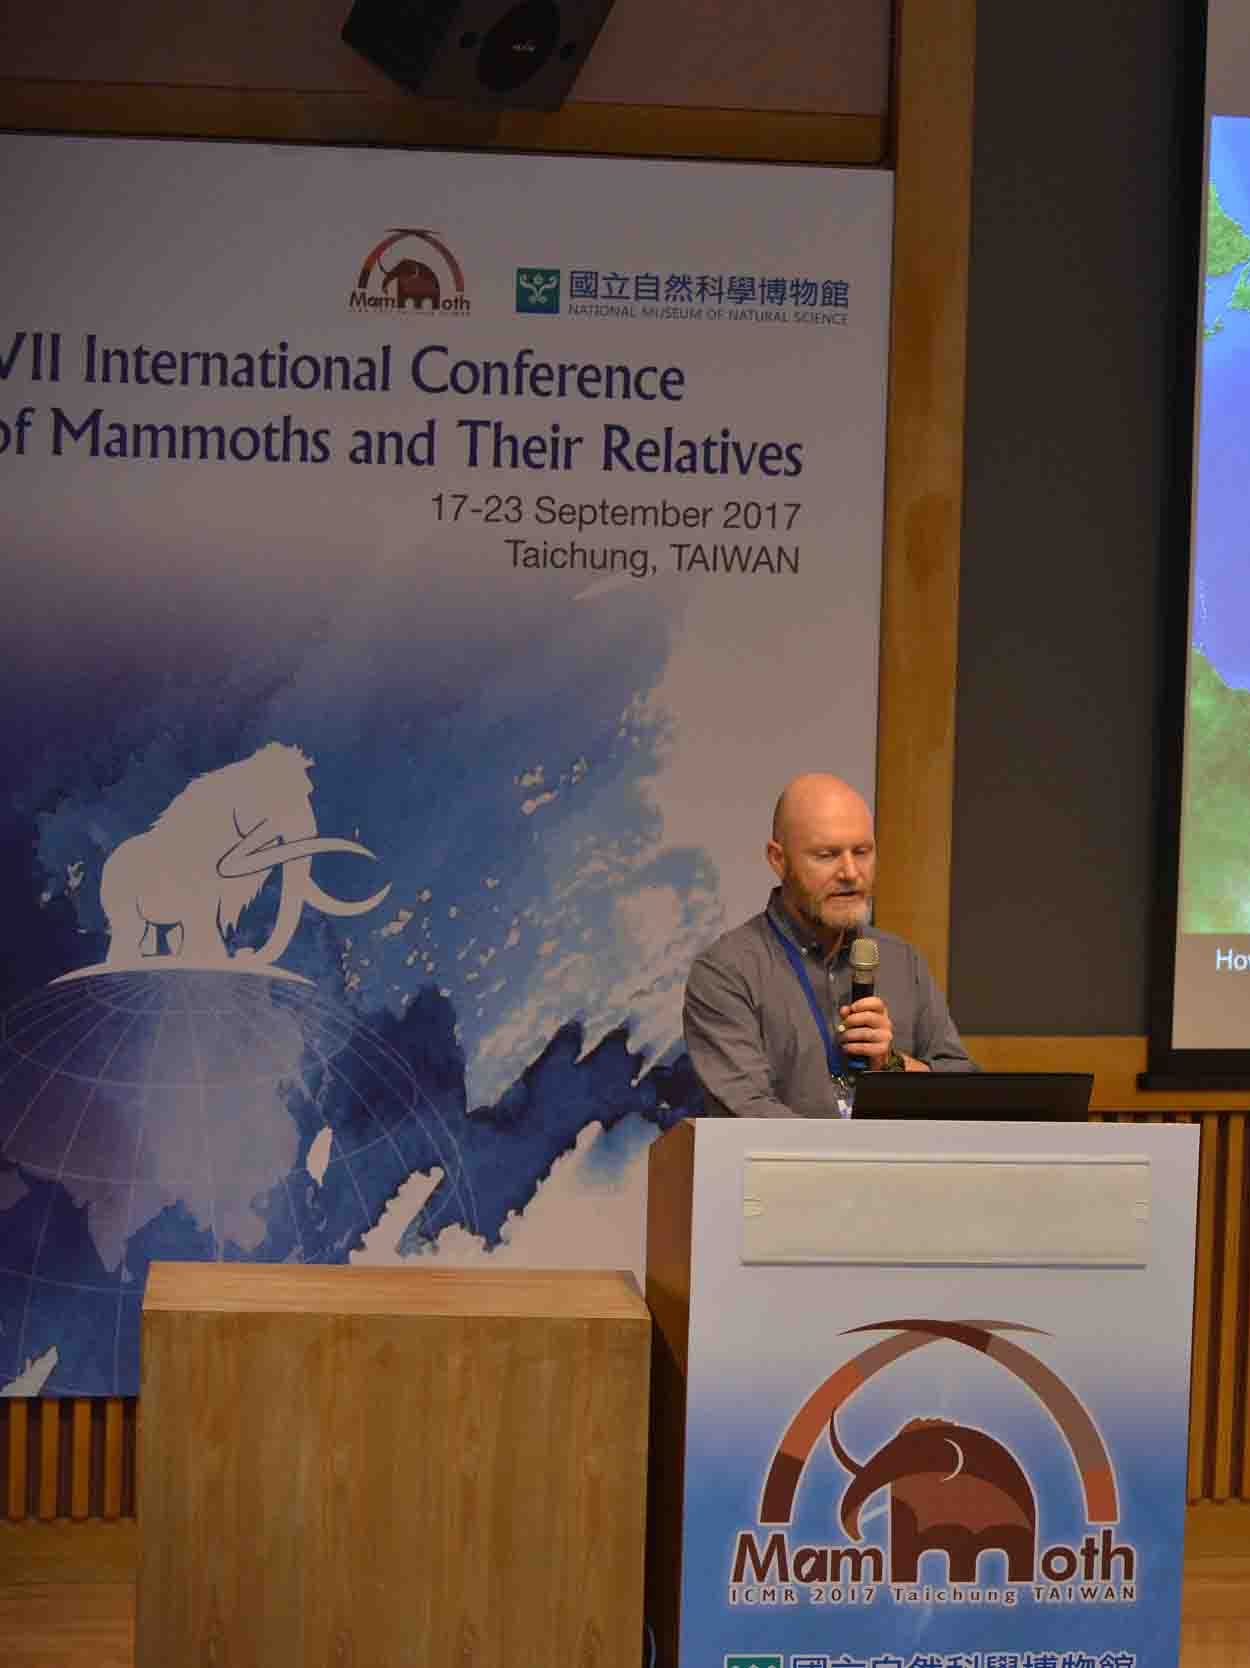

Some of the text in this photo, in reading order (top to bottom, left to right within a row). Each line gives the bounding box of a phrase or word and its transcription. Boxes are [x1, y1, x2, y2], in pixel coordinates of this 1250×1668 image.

[350, 287, 471, 312] Mammoth
[568, 270, 850, 308] 國立自然科學博物館
[568, 303, 849, 326] NATIONAL MUSEUM OF NATURAL SCIENCE
[84, 334, 391, 393] International
[411, 344, 686, 402] Conference
[51, 406, 331, 466] Mammoths
[349, 413, 436, 468] and
[457, 418, 584, 473] Their
[603, 424, 804, 478] Relatives
[430, 493, 801, 534] 17-23 September 2017
[505, 540, 801, 577] Taichung, TAIWAN
[731, 1530, 1136, 1585] Mammoth
[730, 1586, 1137, 1605] ICMR 2017 Taichung TAIWAN
